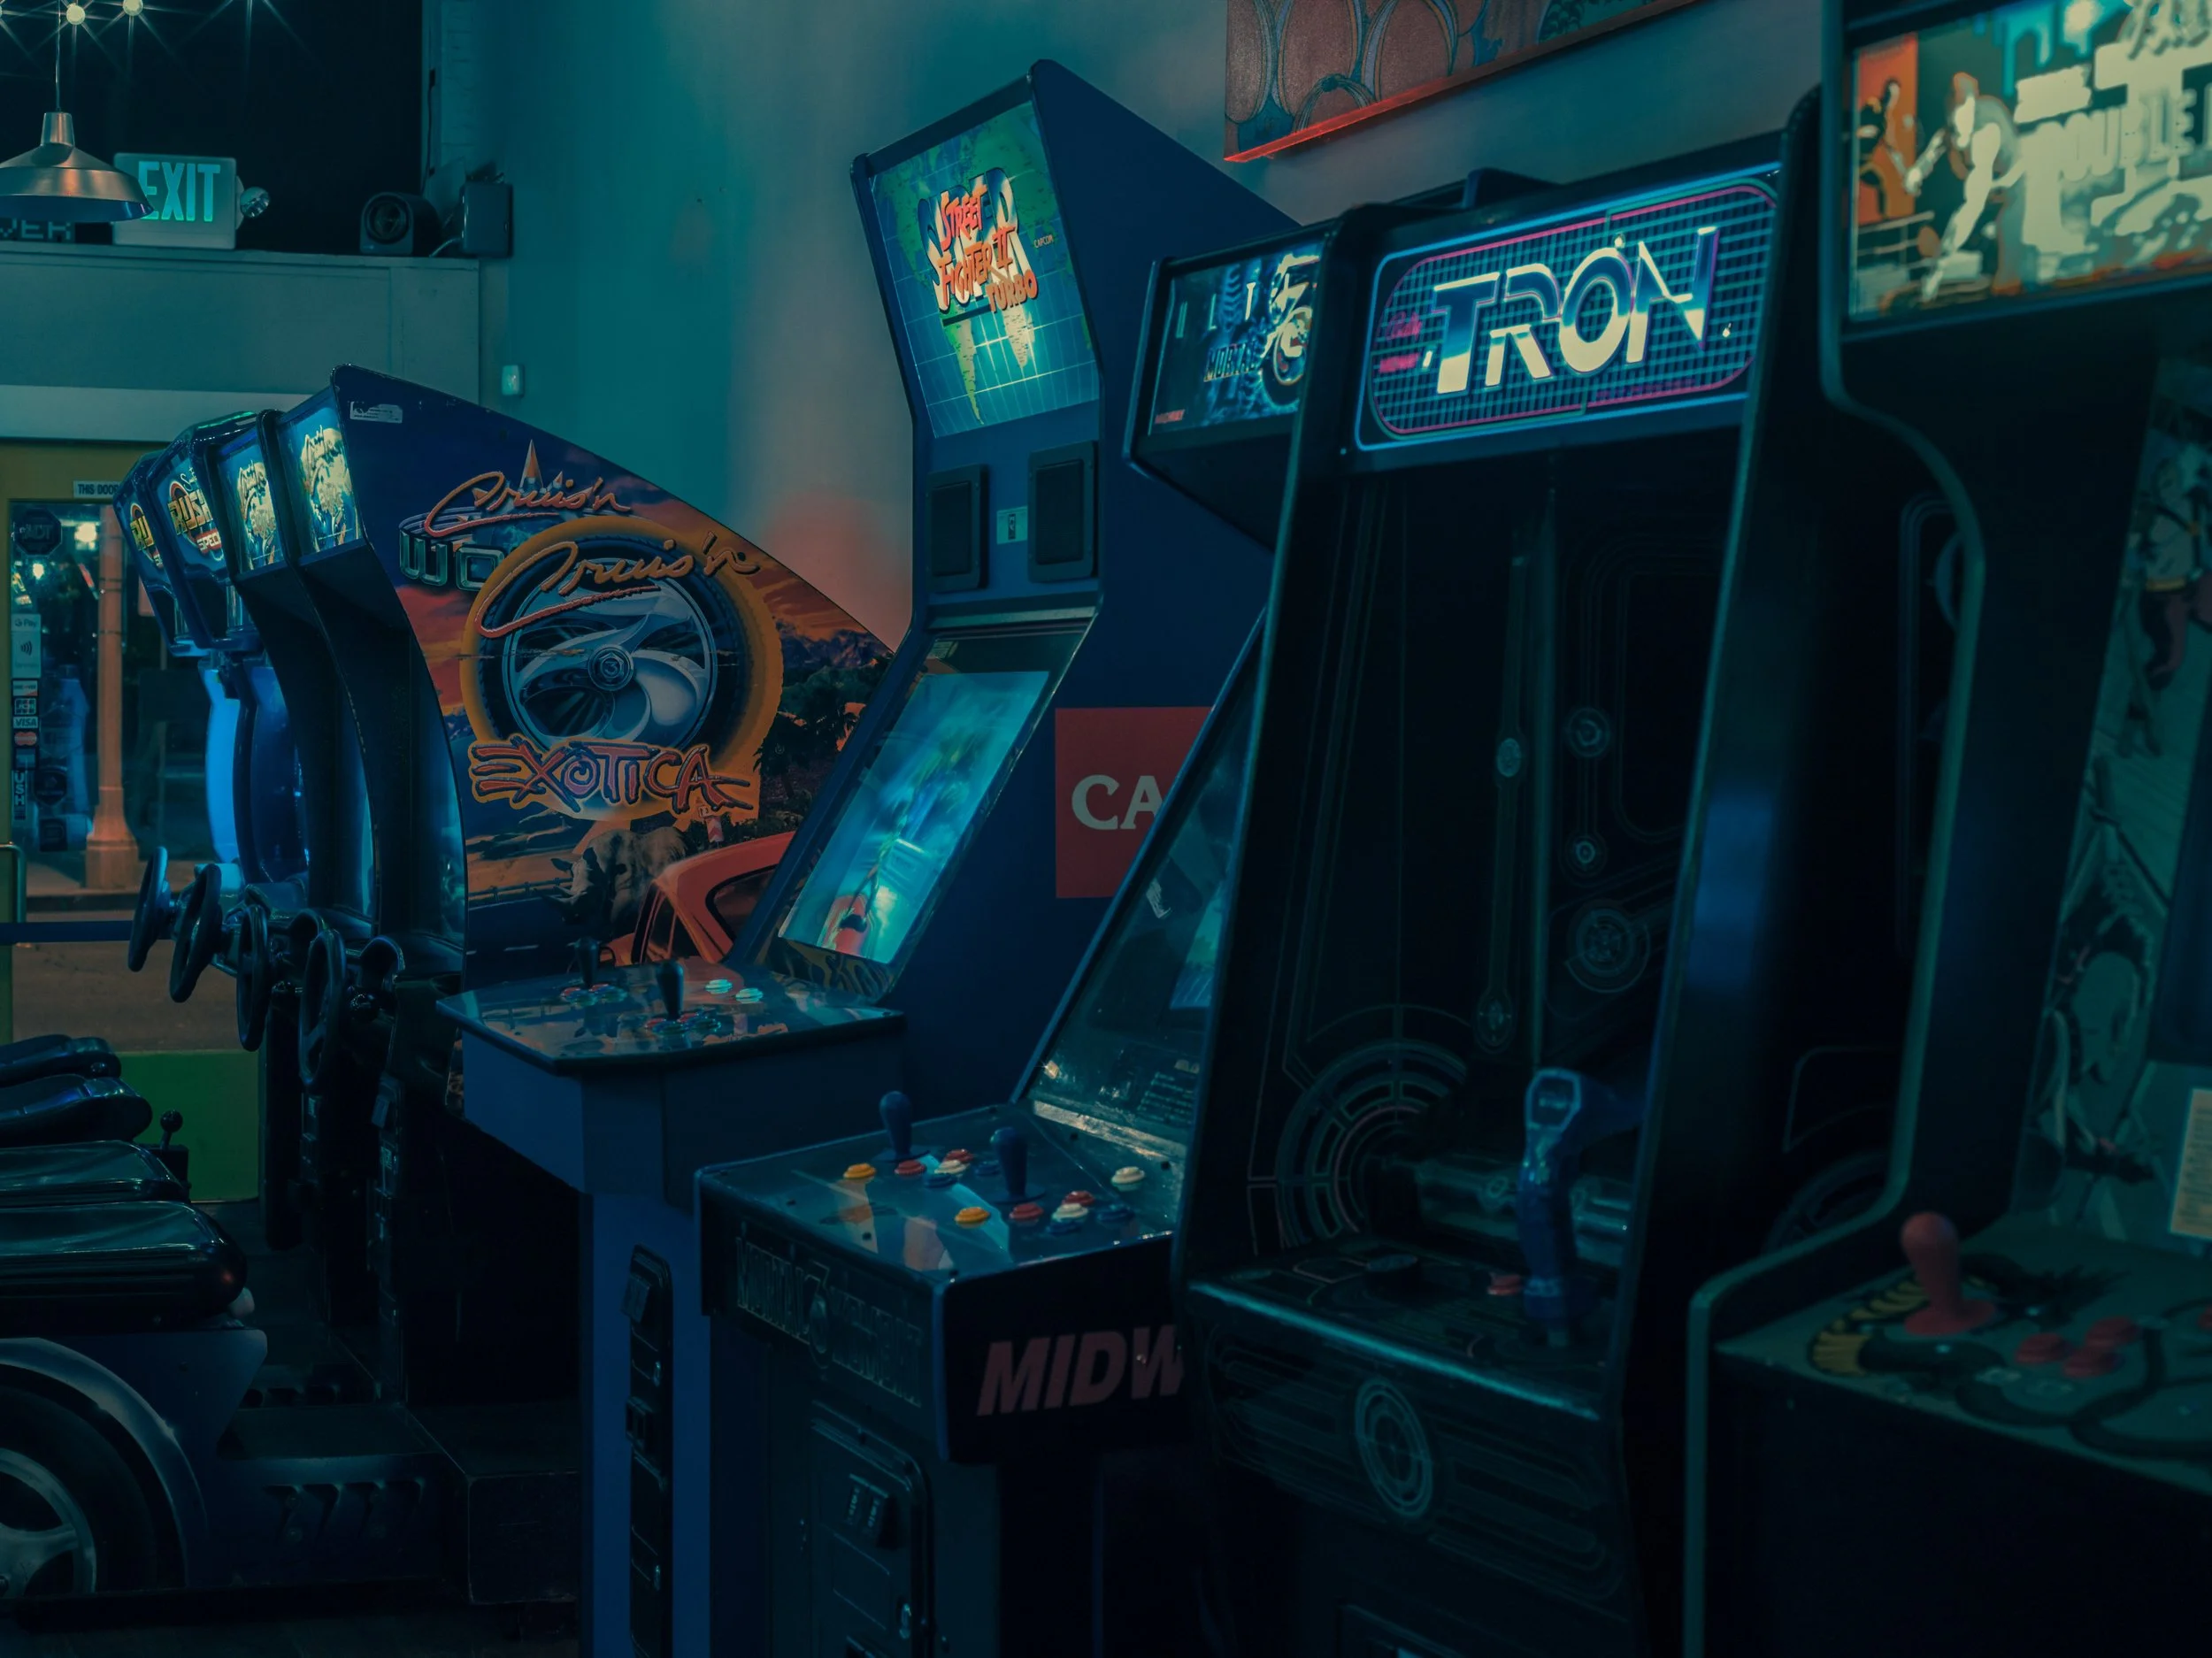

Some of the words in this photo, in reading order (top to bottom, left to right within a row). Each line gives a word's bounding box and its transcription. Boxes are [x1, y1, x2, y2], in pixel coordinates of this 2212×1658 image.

[139, 161, 221, 222] EXIT
[941, 184, 989, 252] STREET
[938, 240, 997, 307] FIGHTER
[986, 269, 1039, 313] TURBO
[1431, 226, 1719, 395] TRON
[78, 483, 95, 495] THIS
[168, 488, 214, 536] RUSH
[15, 718, 37, 727] VISA
[472, 738, 754, 813] EXOTICA
[1071, 774, 1164, 831] CA
[976, 1324, 1185, 1416] MIDW
